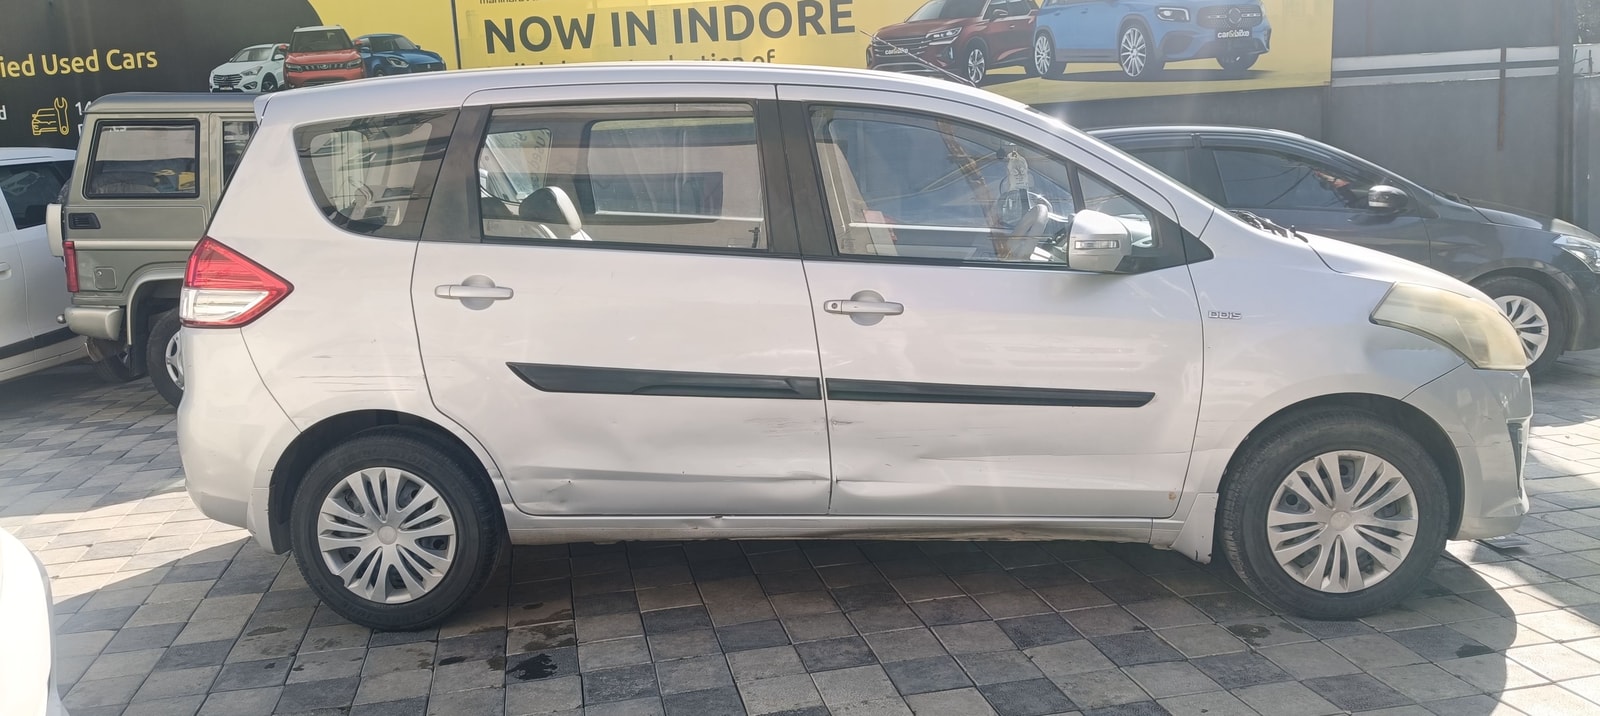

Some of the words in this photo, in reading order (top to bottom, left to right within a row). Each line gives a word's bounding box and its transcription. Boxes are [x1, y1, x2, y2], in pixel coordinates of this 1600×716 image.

[484, 13, 595, 54] NOW
[611, 10, 657, 47] IN
[673, 0, 855, 44] INDORE
[41, 49, 99, 75] Used
[106, 49, 158, 71] Cars
